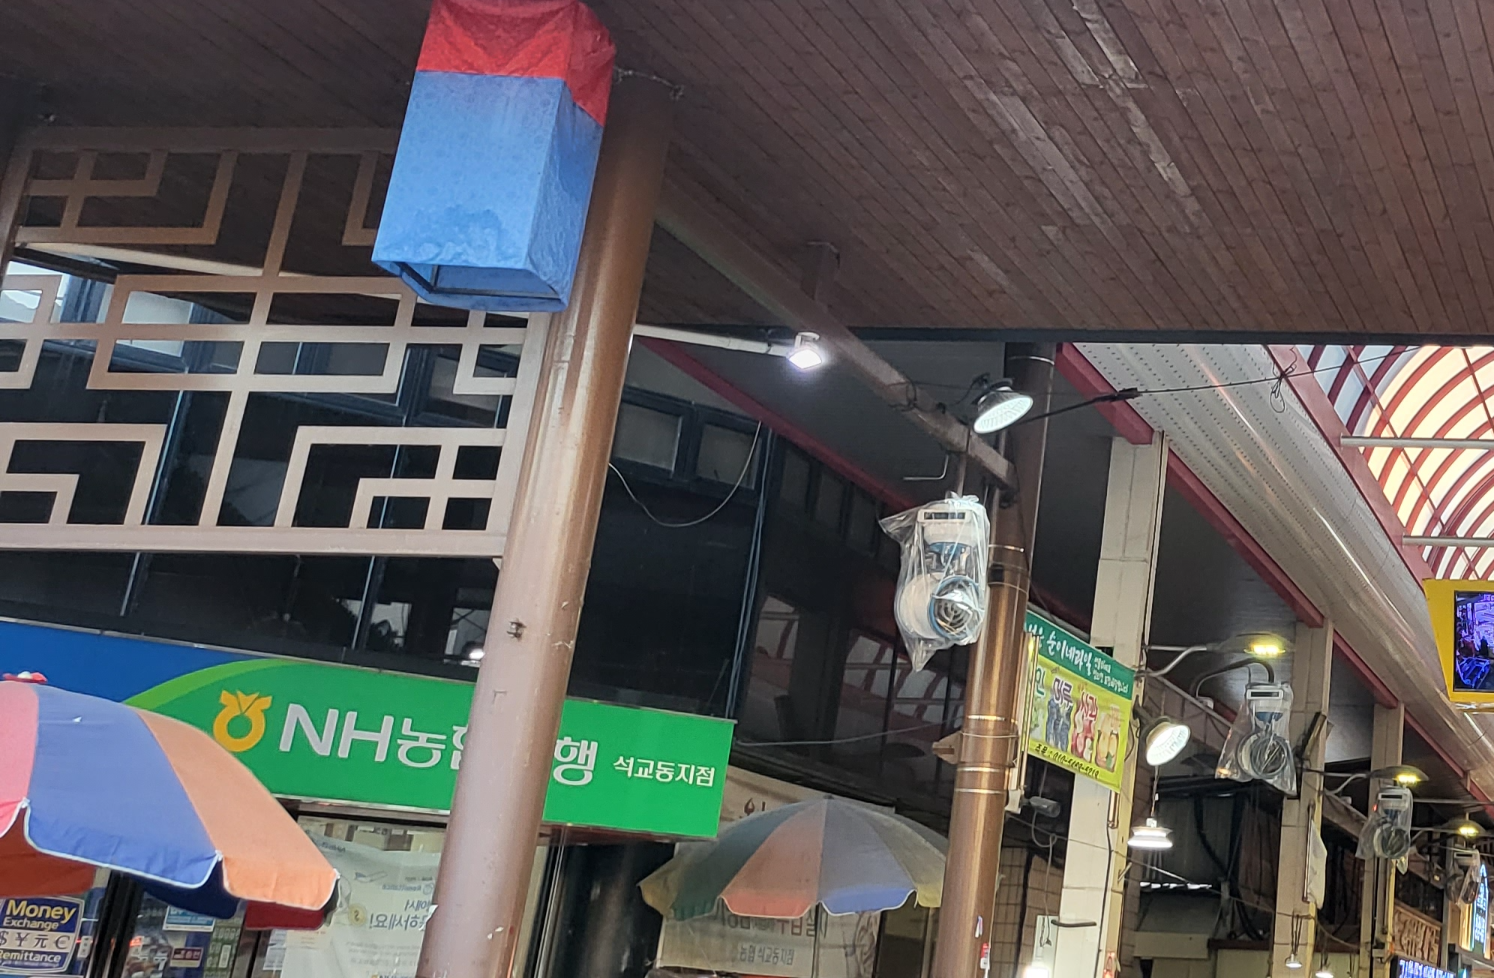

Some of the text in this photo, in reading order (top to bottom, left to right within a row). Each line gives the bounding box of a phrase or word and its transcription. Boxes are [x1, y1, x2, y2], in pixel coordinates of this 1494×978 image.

[279, 703, 716, 787] NH농행 석교동지점
[6, 899, 76, 924] Money
[3, 916, 59, 933] Exchange
